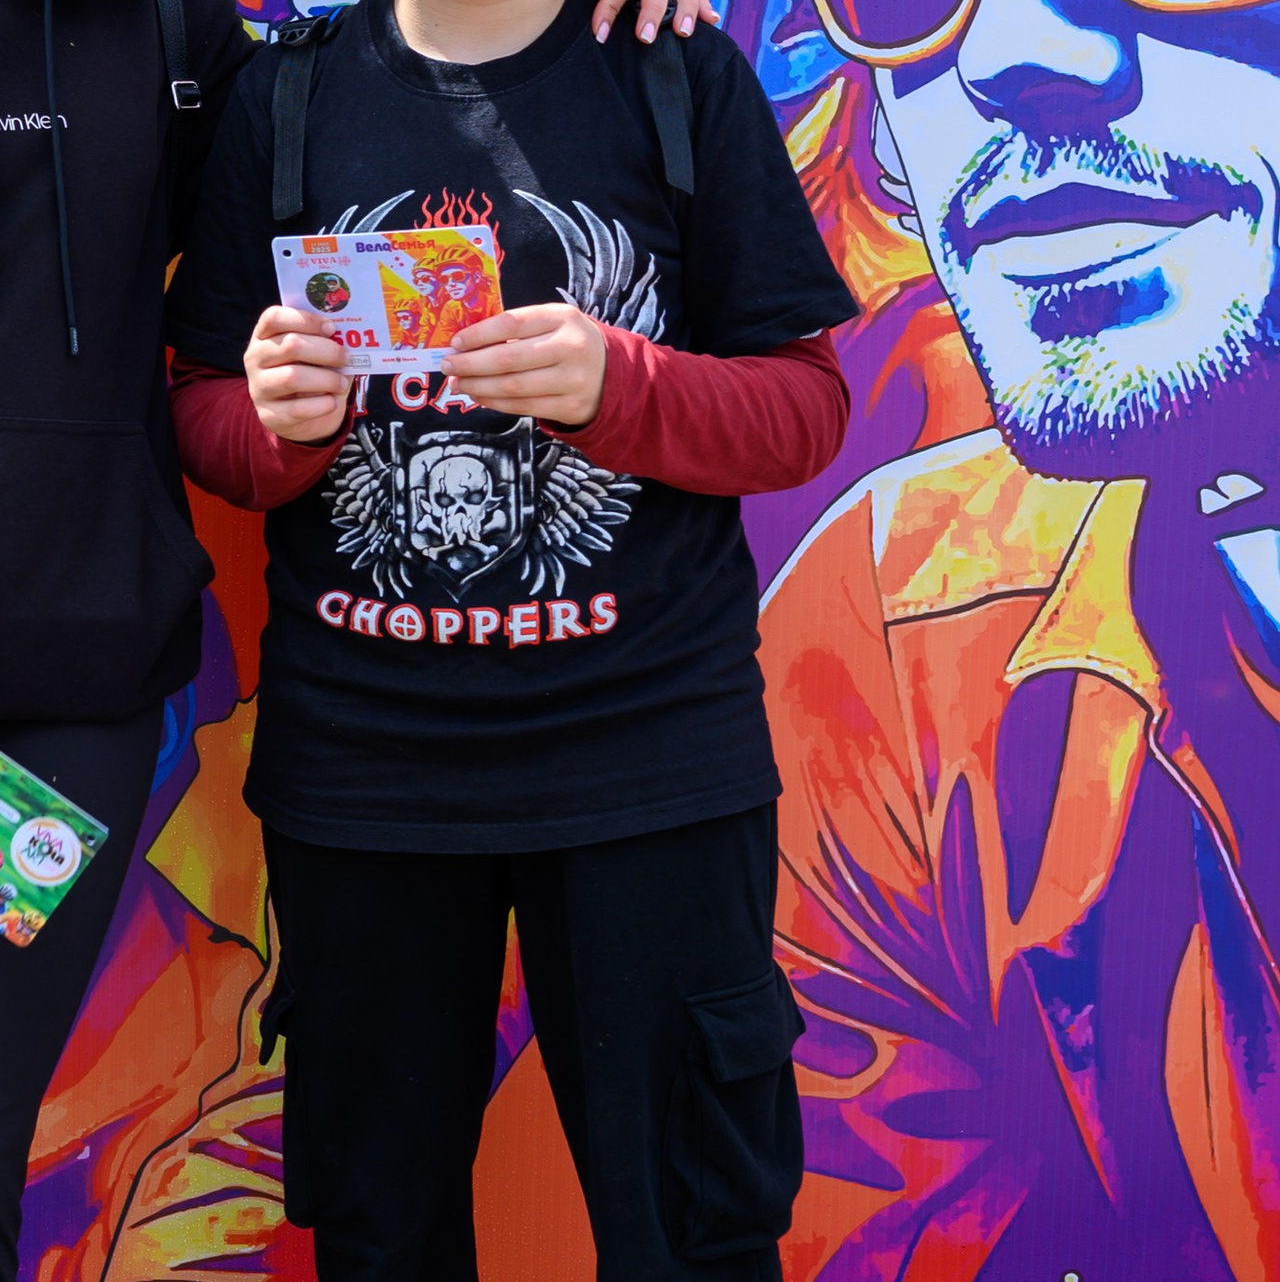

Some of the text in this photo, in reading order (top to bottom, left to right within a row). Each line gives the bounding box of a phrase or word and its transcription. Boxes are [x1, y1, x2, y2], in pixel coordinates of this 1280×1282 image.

[24, 112, 68, 130] Klen
[310, 257, 337, 265] VIVA
[316, 589, 619, 650] CHOPPERS
